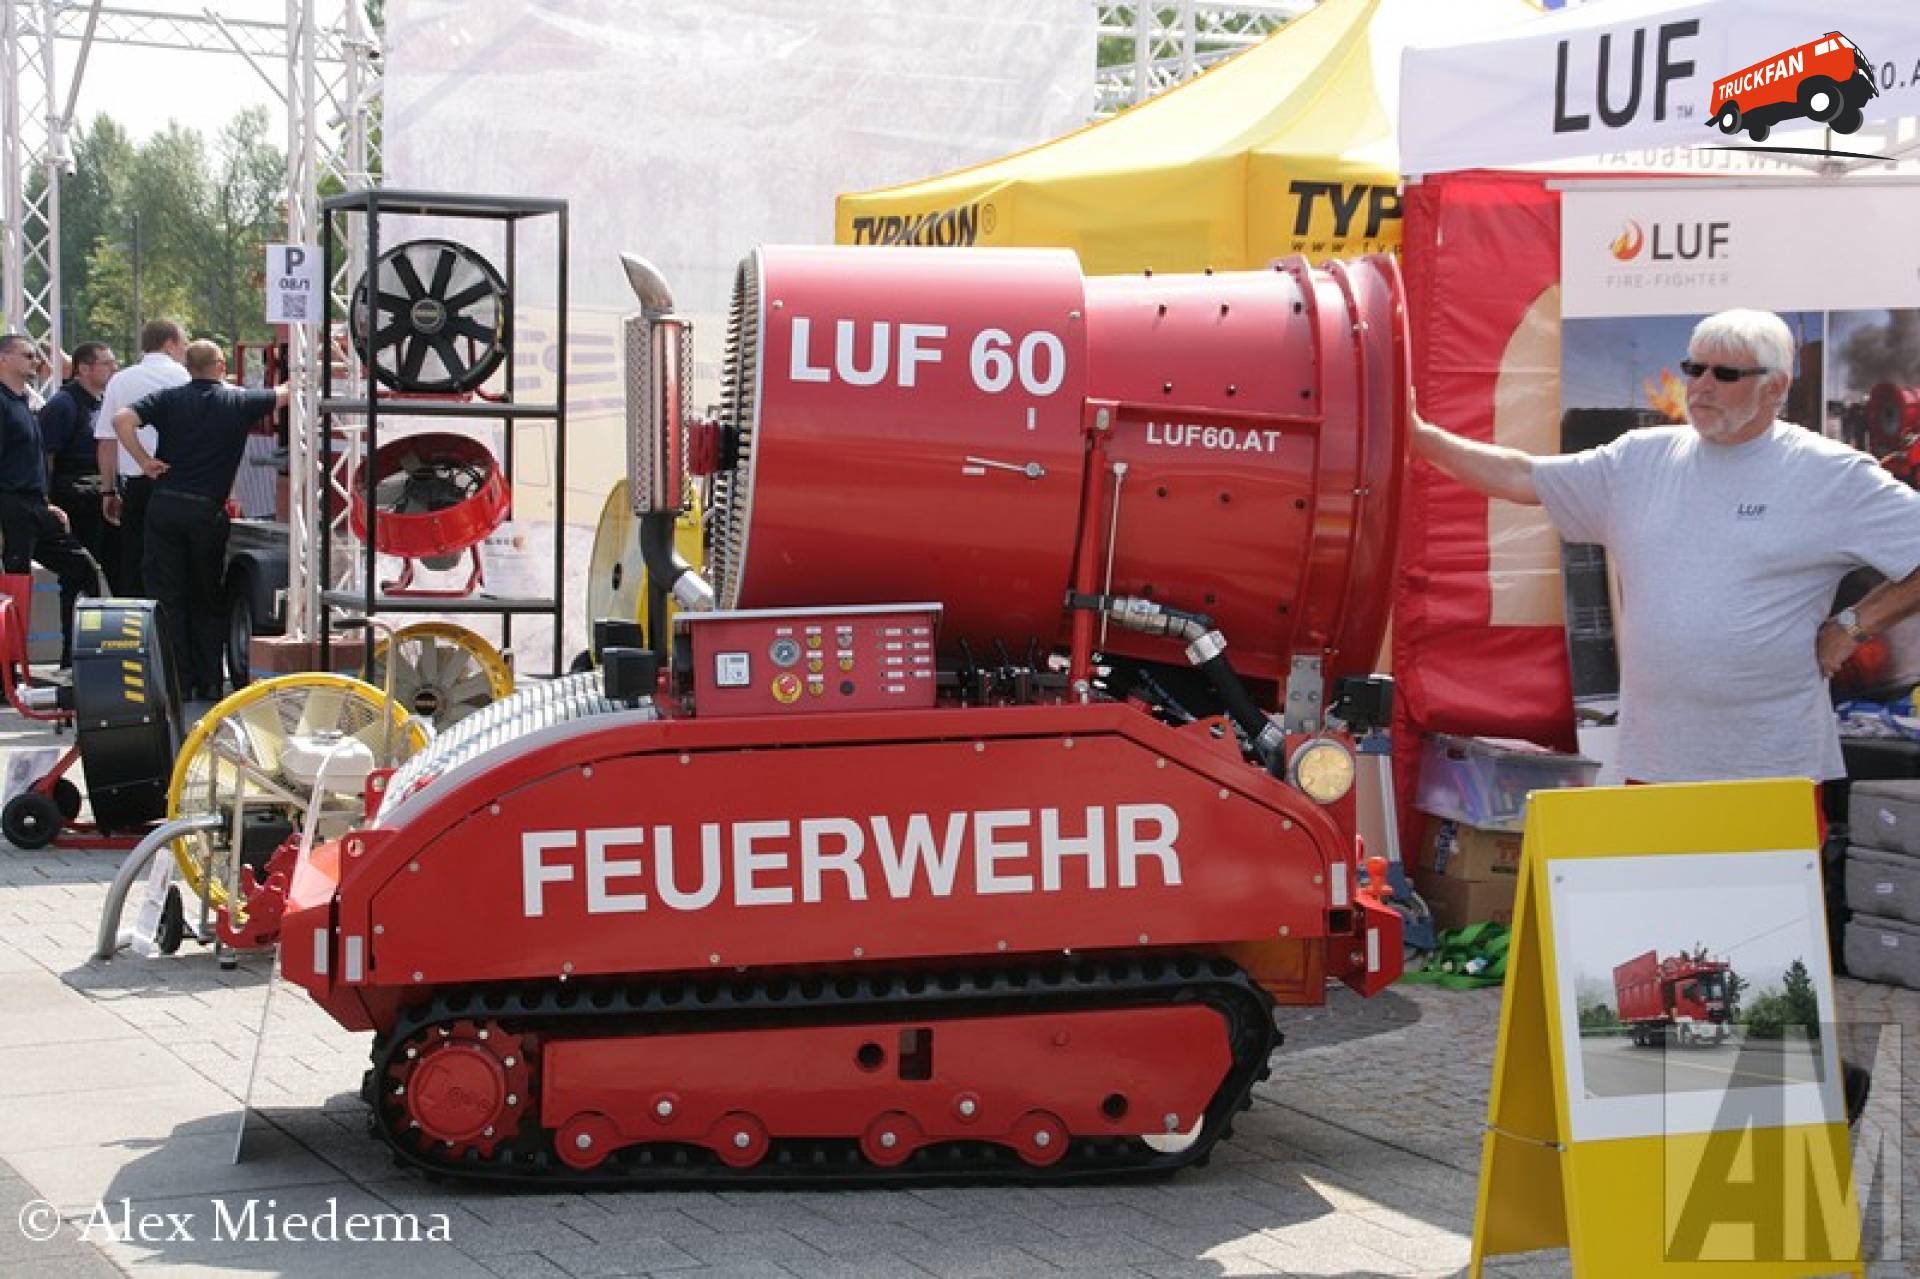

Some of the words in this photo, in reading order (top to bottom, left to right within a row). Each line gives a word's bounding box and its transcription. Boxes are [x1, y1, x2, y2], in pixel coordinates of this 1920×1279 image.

[1553, 18, 1700, 133] LUF
[286, 247, 305, 275] P
[1652, 222, 1730, 260] LUF
[790, 317, 948, 387] LUF
[970, 328, 1066, 396] 60
[1146, 421, 1282, 452] LUF60.AT
[522, 803, 1182, 917] FEUERWEHR
